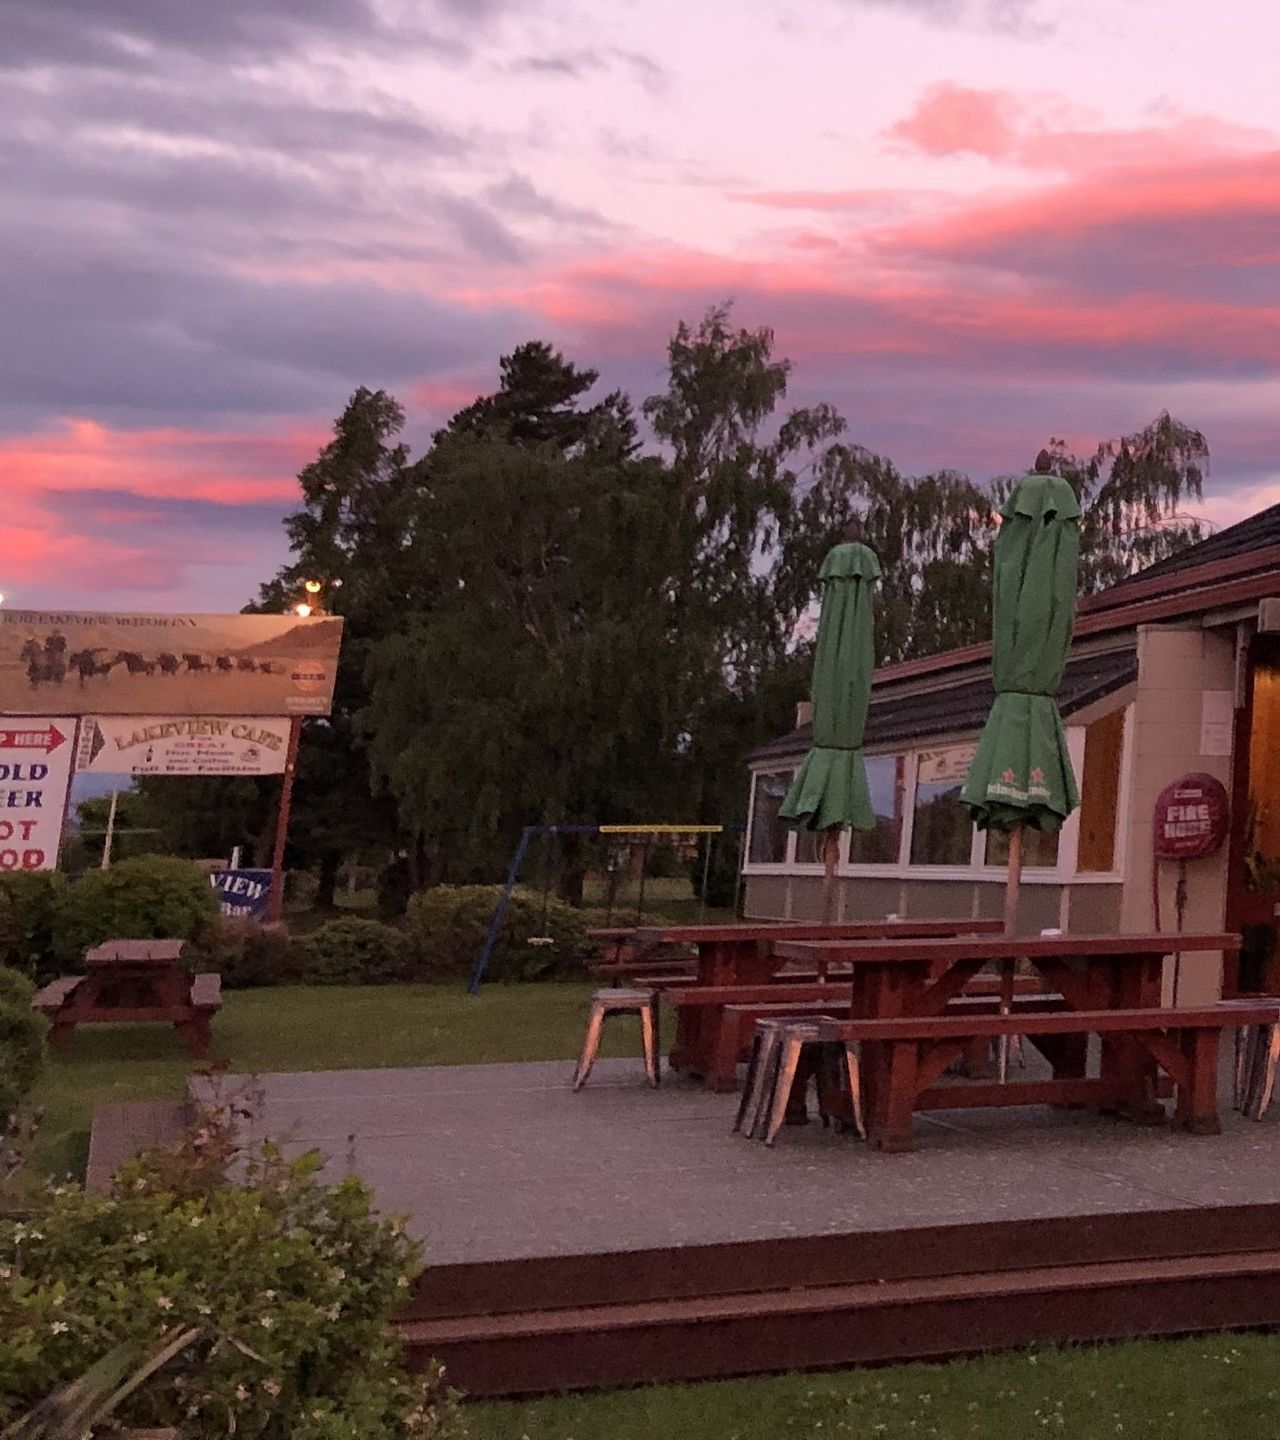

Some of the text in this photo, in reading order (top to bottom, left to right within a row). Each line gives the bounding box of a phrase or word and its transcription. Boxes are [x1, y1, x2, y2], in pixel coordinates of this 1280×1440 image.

[14, 732, 53, 746] HERE
[114, 719, 284, 752] LAKEVIEW CAFE
[0, 763, 49, 781] OLD
[1166, 804, 1210, 822] FIRE
[0, 820, 38, 841] OT
[0, 848, 45, 869] OD
[209, 873, 269, 901] VIEW
